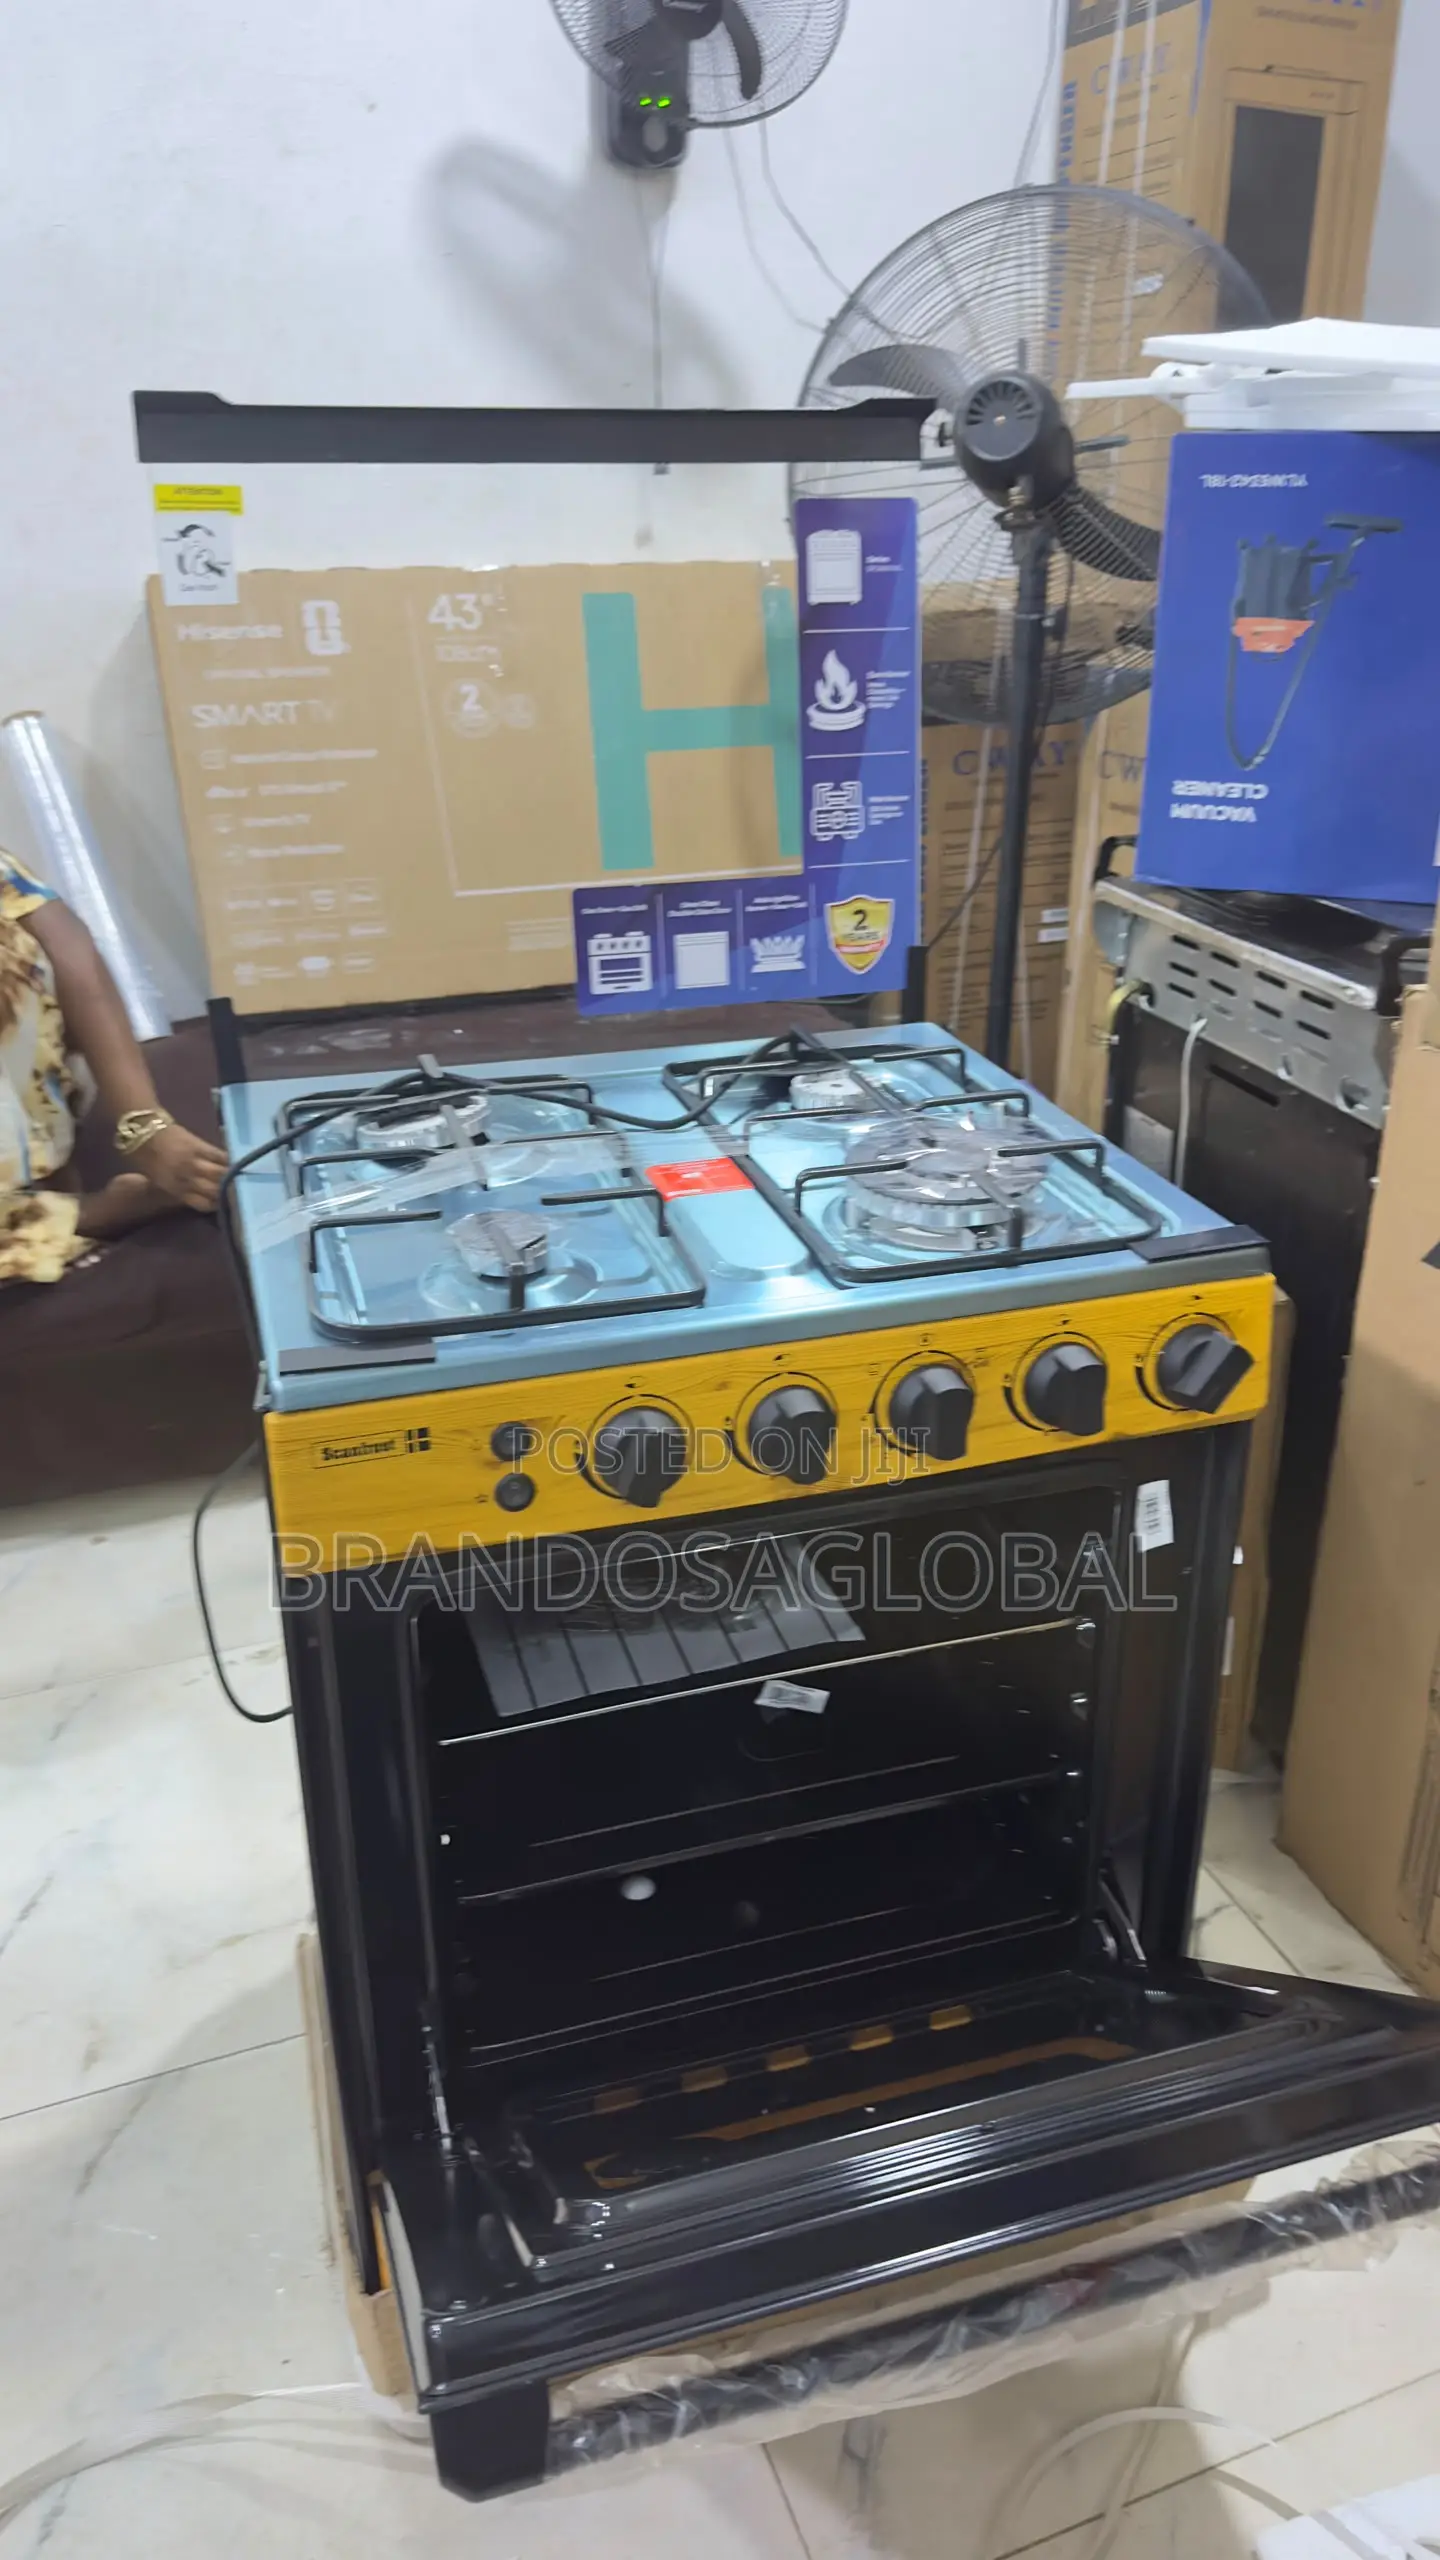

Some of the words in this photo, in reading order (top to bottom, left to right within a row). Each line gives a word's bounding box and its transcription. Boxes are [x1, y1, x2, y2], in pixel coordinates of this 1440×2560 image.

[191, 700, 298, 728] SMART
[1171, 780, 1269, 800] CLEANER
[1169, 803, 1257, 823] VACUUM
[852, 909, 868, 931] 2
